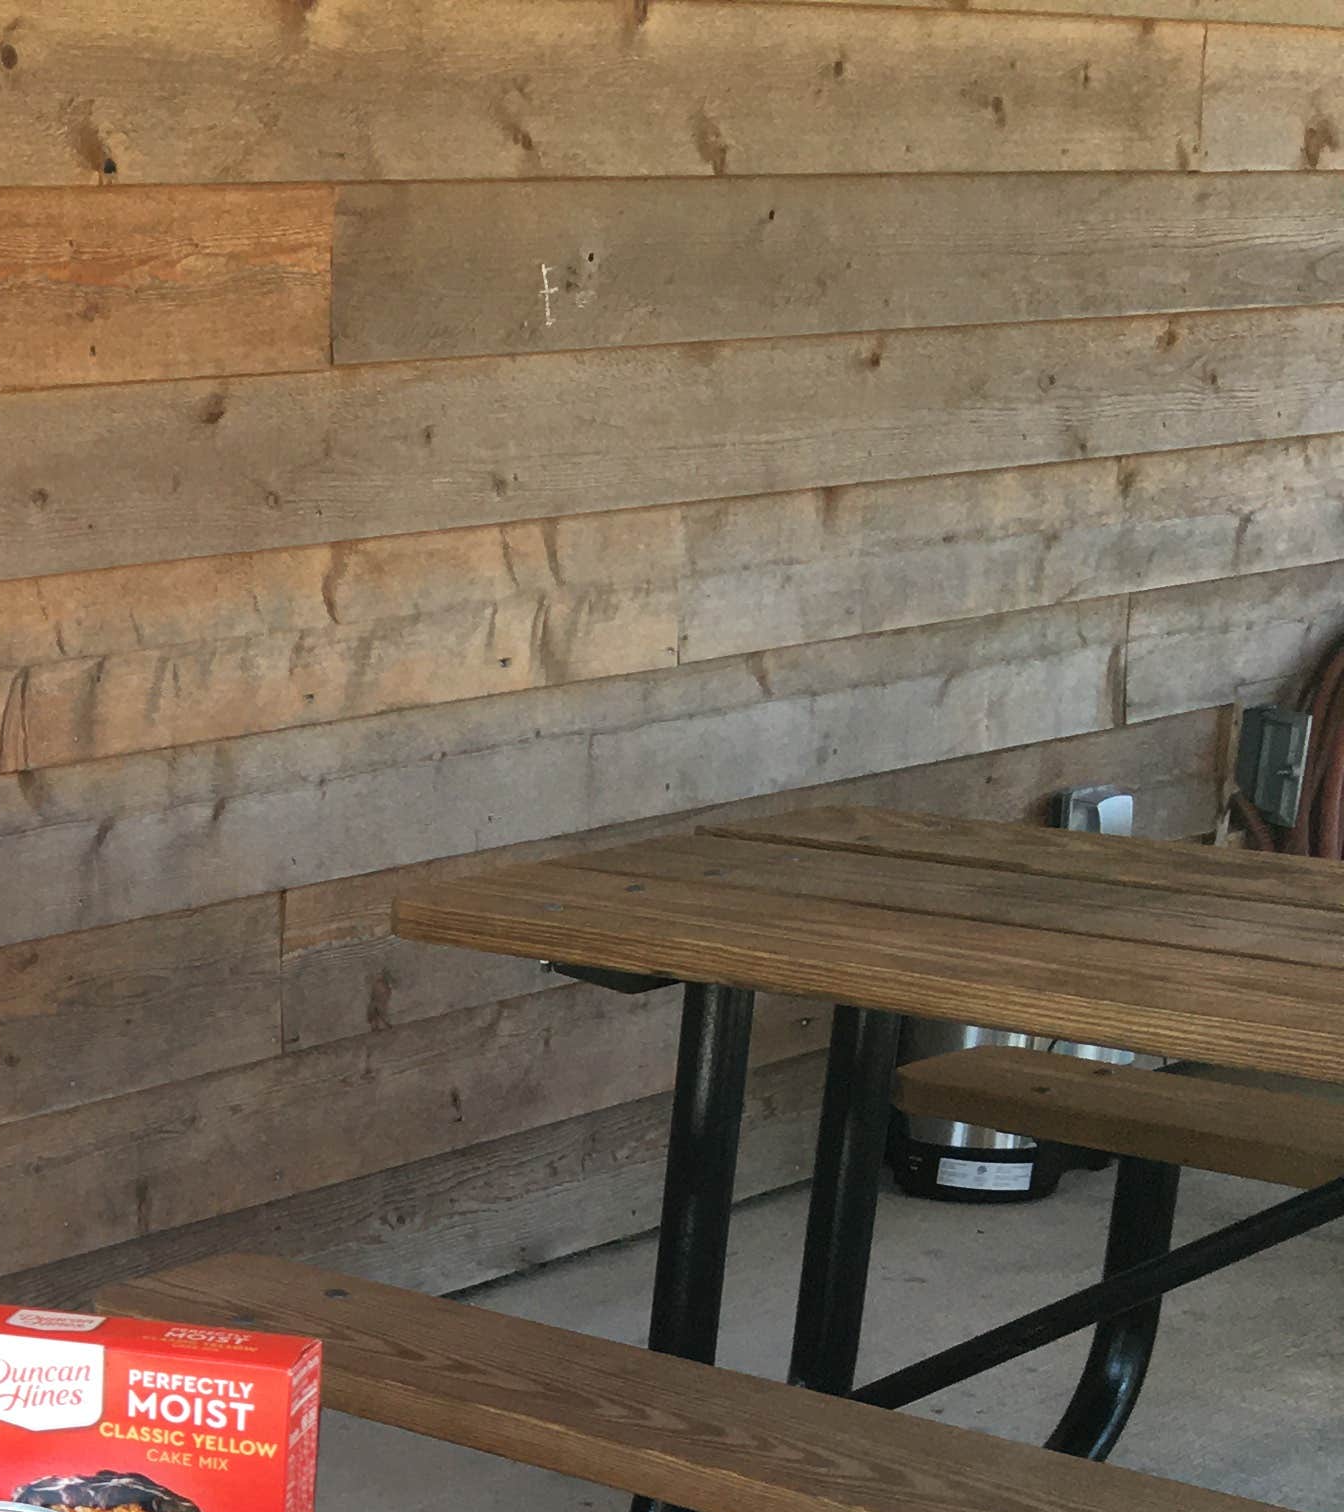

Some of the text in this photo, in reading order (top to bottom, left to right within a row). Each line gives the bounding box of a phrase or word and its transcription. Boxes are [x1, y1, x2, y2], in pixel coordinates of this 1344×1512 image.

[163, 1331, 249, 1345] MOIST
[128, 1369, 254, 1399] PERFECTLY
[127, 1389, 255, 1431] MOIST
[99, 1421, 278, 1459] CLASSIC YELLOW
[146, 1449, 229, 1471] CAKE MIX
